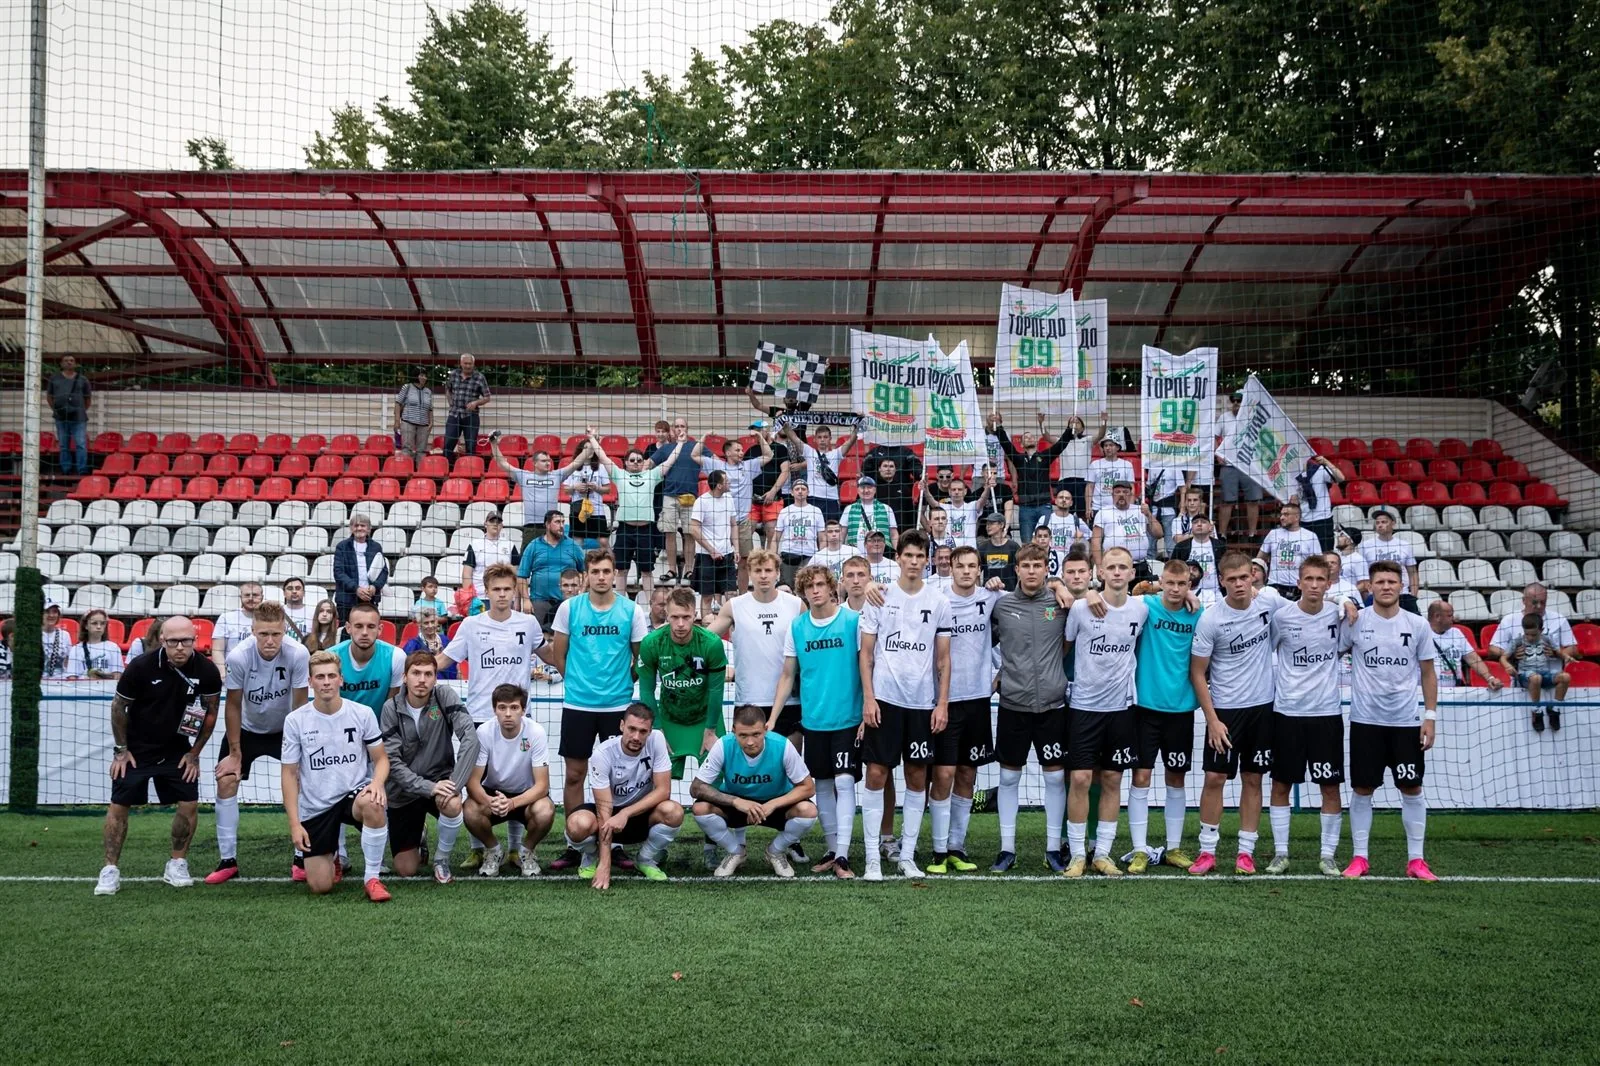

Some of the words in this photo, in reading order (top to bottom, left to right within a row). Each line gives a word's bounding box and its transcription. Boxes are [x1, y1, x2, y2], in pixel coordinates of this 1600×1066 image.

[1009, 314, 1066, 340] ТОРПЕДО
[1018, 338, 1053, 369] 99
[862, 358, 926, 388] ТОРПЕДО
[874, 383, 909, 414] 99
[930, 393, 960, 429] 99
[1160, 400, 1197, 434] 99
[793, 526, 806, 538] 99
[1053, 536, 1067, 546] 99
[1281, 551, 1294, 562] 99
[582, 624, 620, 636] Joma
[950, 623, 986, 635] NGRAD
[1154, 618, 1193, 634] Joma
[805, 637, 844, 653] Joma
[888, 638, 926, 651] INGRAD
[1093, 644, 1131, 653] INGRAD
[1233, 631, 1269, 652] INGRAD
[484, 657, 522, 666] INGRAD
[1296, 652, 1334, 664] INGRAD
[1367, 655, 1409, 666] INGRAD
[665, 678, 703, 688] INGRAD
[251, 688, 288, 703] INGRAD
[910, 741, 928, 759] 26
[969, 744, 986, 762] 84
[1042, 742, 1063, 760] 88
[1112, 747, 1131, 764] 43
[313, 754, 357, 767] INGRAD
[835, 752, 849, 769] 31
[1167, 752, 1186, 767] 59
[1313, 762, 1332, 779] 58
[1396, 763, 1416, 780] 95
[732, 773, 772, 785] Joma
